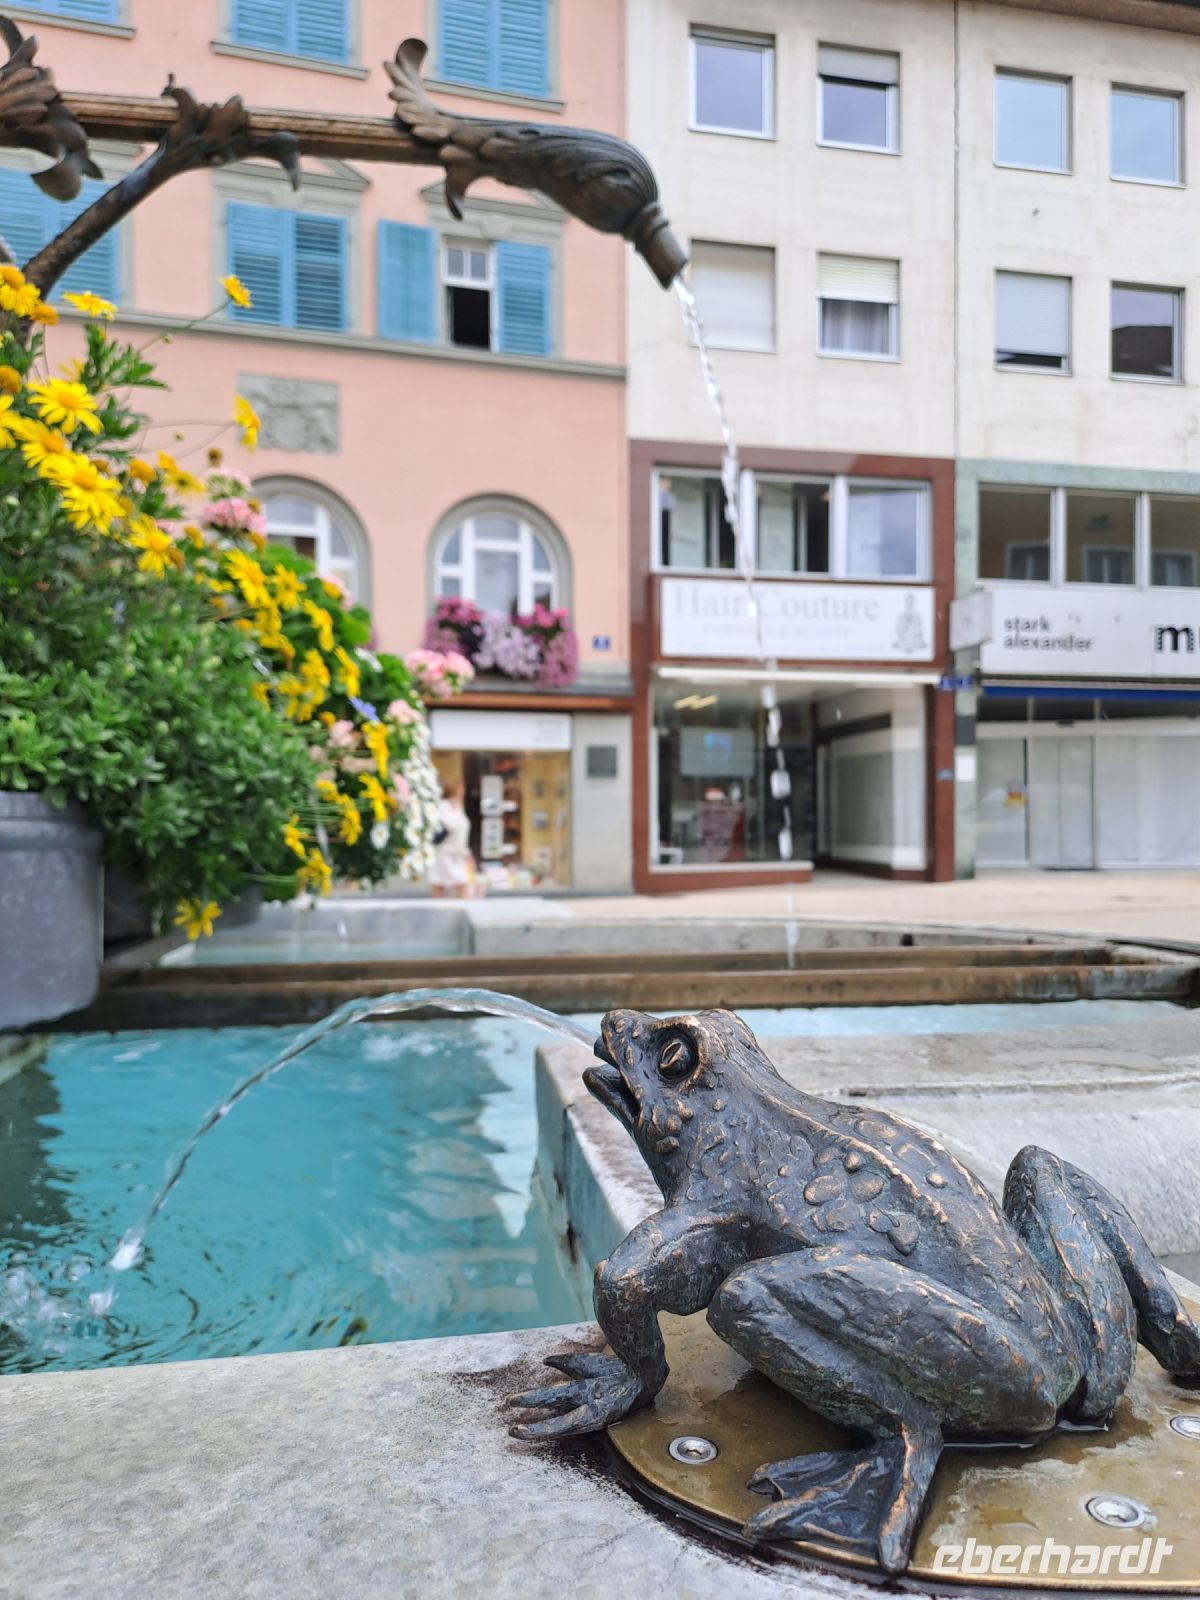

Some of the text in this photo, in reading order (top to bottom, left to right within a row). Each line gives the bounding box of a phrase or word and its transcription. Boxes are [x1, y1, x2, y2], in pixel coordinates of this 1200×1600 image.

[674, 584, 881, 621] Hair Couture
[1004, 614, 1051, 632] stark
[1004, 632, 1093, 651] alexander
[1155, 625, 1200, 651] m
